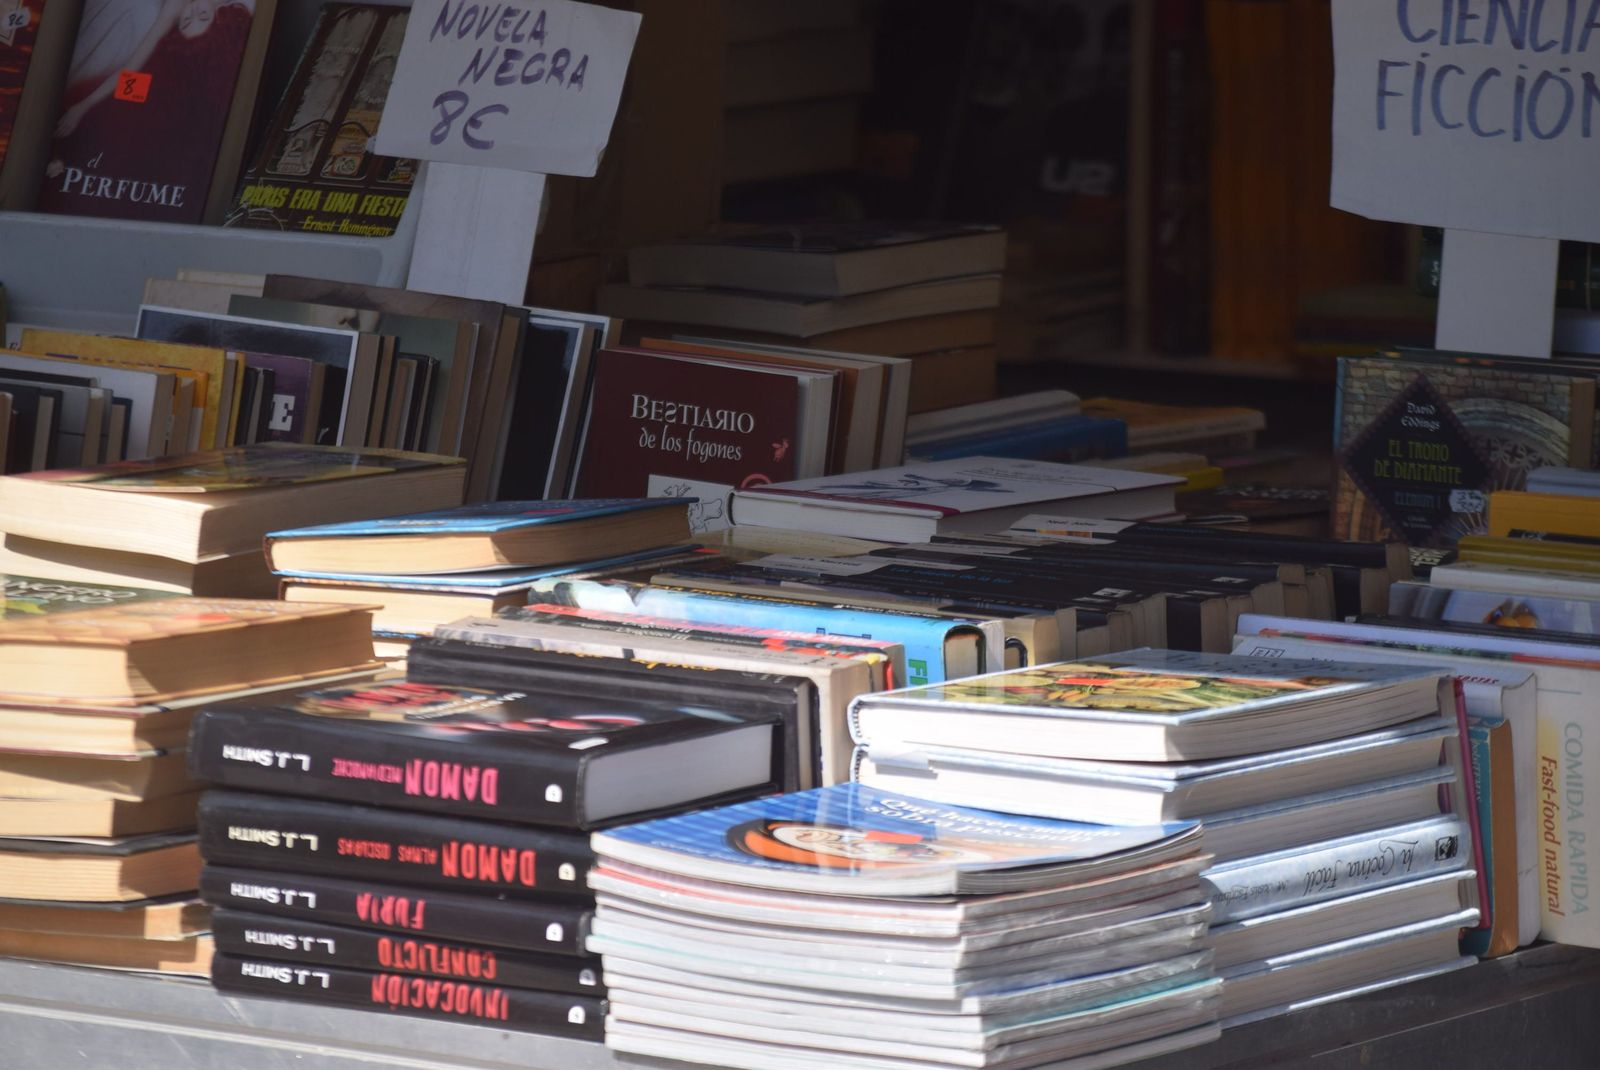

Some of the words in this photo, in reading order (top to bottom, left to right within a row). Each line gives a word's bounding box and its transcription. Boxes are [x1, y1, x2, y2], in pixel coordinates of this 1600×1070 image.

[430, 0, 548, 47] NOVELA
[457, 47, 588, 92] NEGRA
[430, 90, 509, 150] 8€
[87, 152, 103, 168] el
[60, 166, 185, 207] PERFUME
[289, 189, 322, 211] ERA
[323, 192, 359, 214] UNA
[303, 215, 336, 231] Ernest
[267, 393, 296, 432] E
[630, 393, 755, 434] BESTIARIO
[639, 427, 656, 449] de
[661, 425, 682, 452] los
[686, 427, 742, 463] fogones
[1388, 439, 1404, 457] EL
[1374, 459, 1391, 478] DE
[1393, 461, 1463, 485] DIAMANTE
[331, 757, 403, 784] MEDIANOCHE
[404, 758, 499, 805] DAMON
[1564, 722, 1585, 821] COMIDA
[1542, 756, 1561, 846] Fast-food
[337, 837, 391, 859] OSCURAS
[397, 844, 438, 865] ALMAS
[441, 839, 536, 887] DAMON
[1545, 848, 1565, 916] natural
[356, 892, 426, 930] FURIA
[377, 937, 496, 979] CONFLICTO
[371, 973, 509, 1020] INVOCACIÓN
